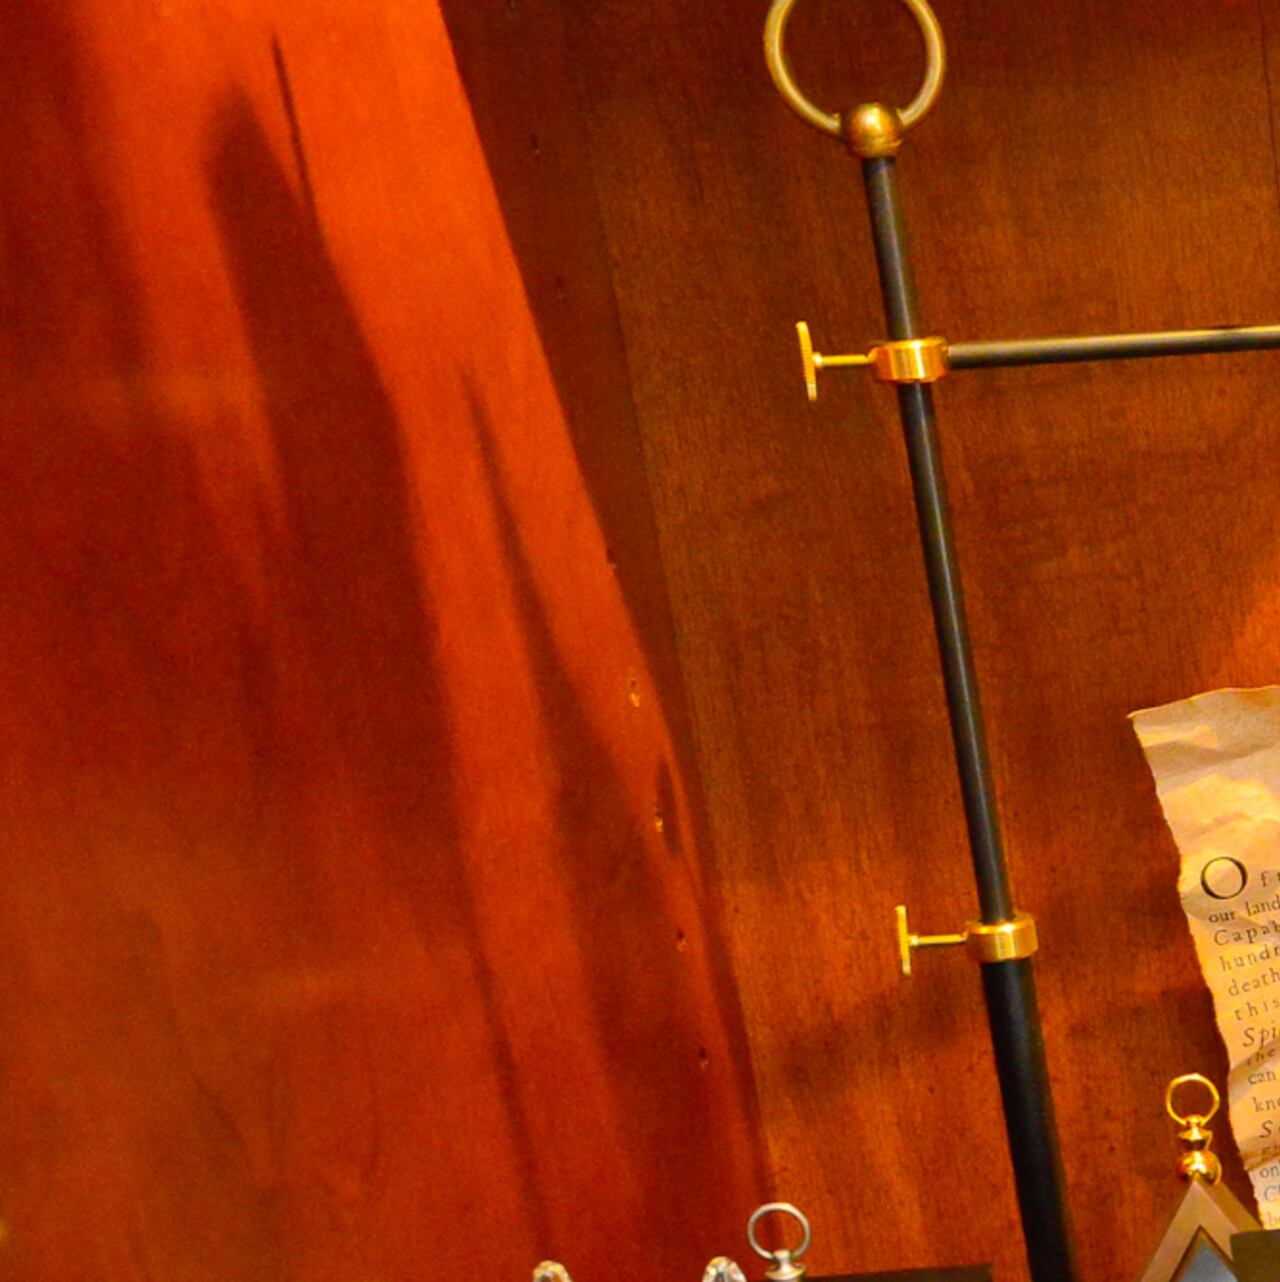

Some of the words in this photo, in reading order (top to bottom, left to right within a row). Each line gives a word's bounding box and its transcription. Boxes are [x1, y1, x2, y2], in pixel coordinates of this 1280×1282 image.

[1208, 910, 1236, 924] our
[1234, 998, 1280, 1021] this
[1248, 1069, 1277, 1085] can
